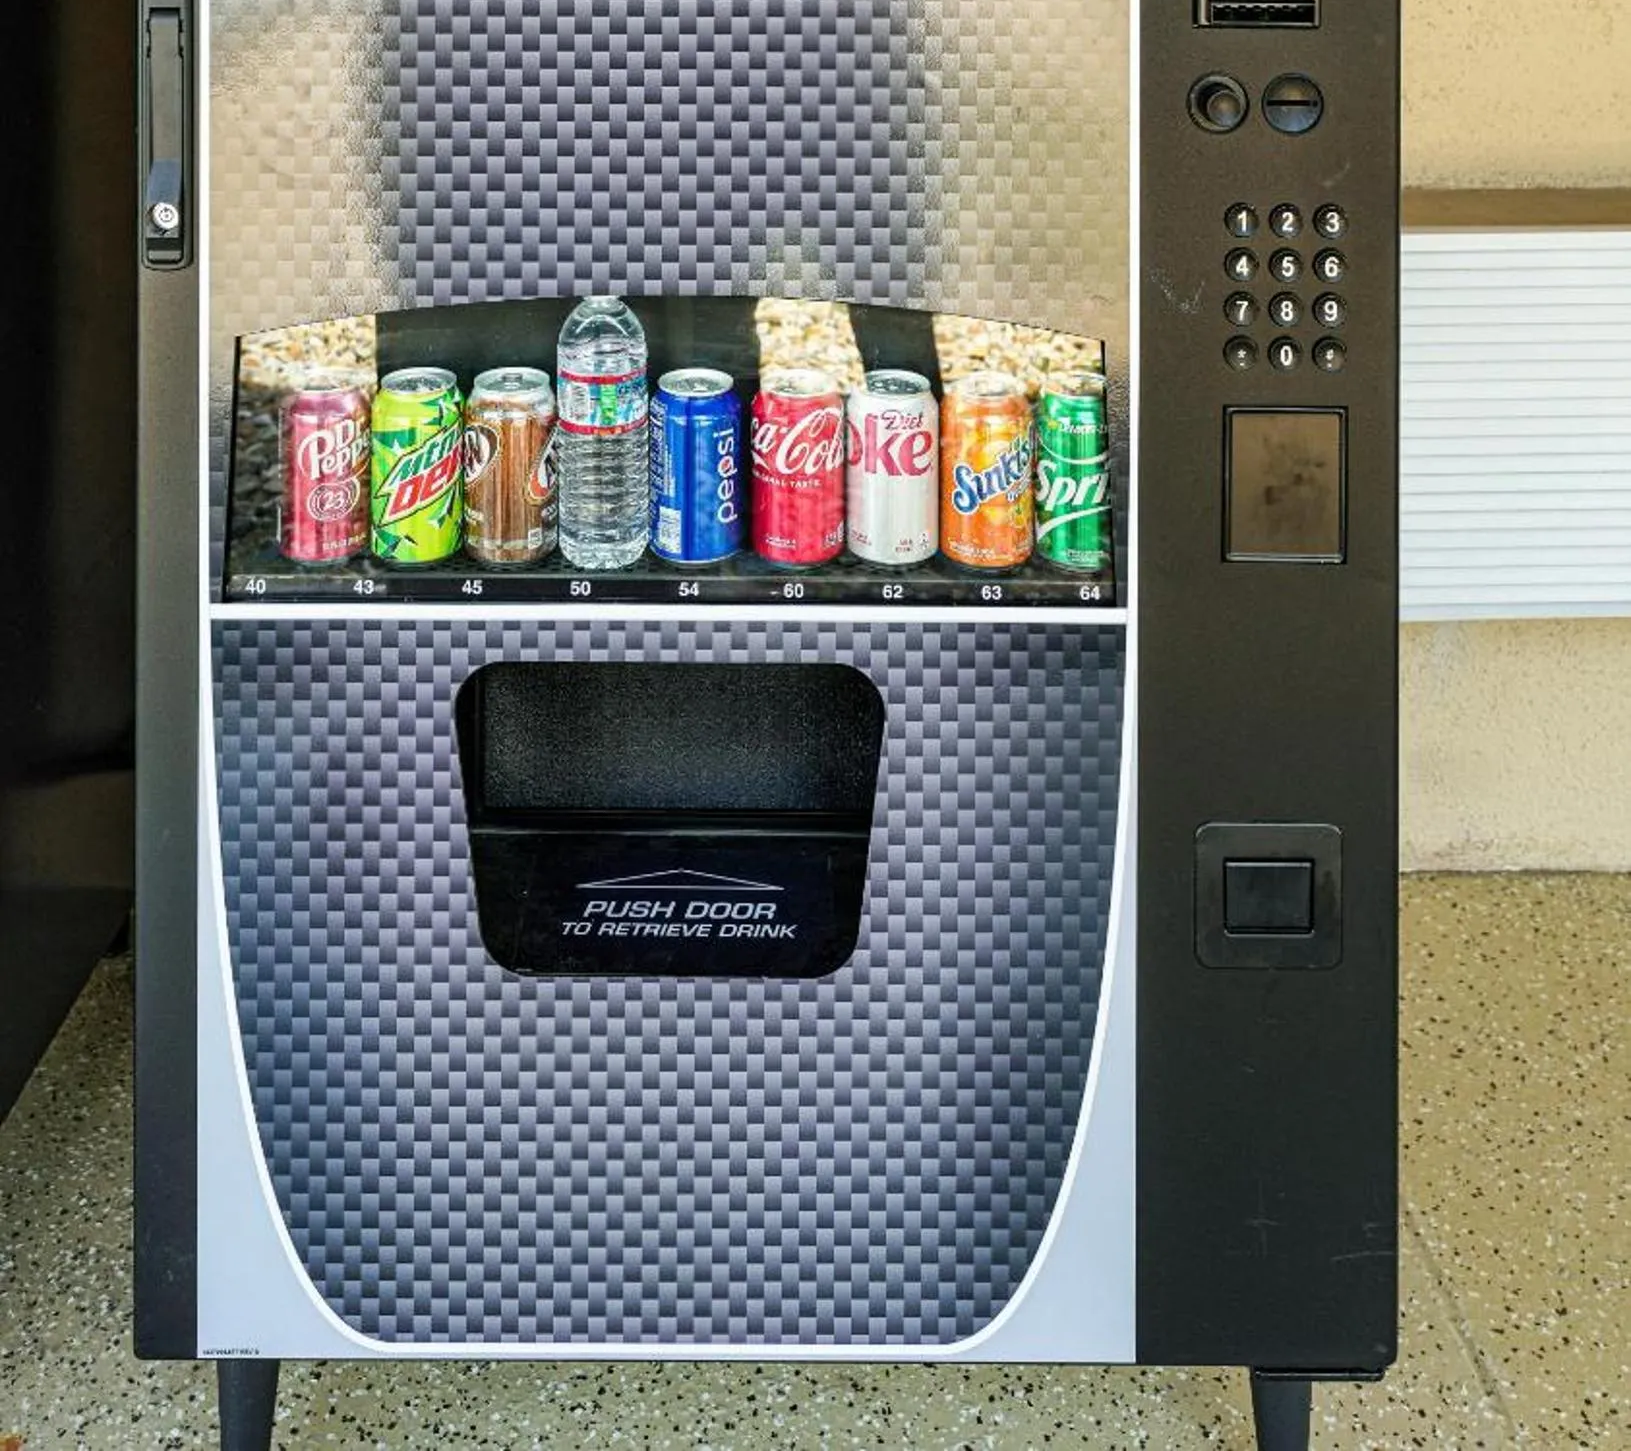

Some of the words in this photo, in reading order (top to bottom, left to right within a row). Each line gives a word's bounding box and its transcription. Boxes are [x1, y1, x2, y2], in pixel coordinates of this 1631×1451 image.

[1237, 212, 1248, 232] 1
[1281, 212, 1293, 232] 2
[1326, 212, 1340, 233] 3
[1235, 256, 1249, 276] 4
[1282, 256, 1295, 277] 5
[1324, 256, 1340, 277] 6
[1236, 301, 1248, 321] 7
[1281, 301, 1294, 322] 8
[1324, 301, 1338, 322] 9
[1280, 346, 1293, 366] 0
[713, 427, 738, 524] pepsi
[1036, 459, 1109, 512] Spri
[245, 580, 266, 594] 40
[353, 580, 374, 594] 43
[461, 580, 482, 594] 45
[570, 582, 591, 596] 50
[678, 582, 699, 596] 54
[783, 584, 804, 598] 60
[882, 585, 903, 599] 62
[981, 585, 1002, 599] 63
[1079, 585, 1101, 599] 64
[583, 901, 676, 919] PUSH
[684, 901, 777, 920] DOOR
[561, 922, 592, 936] TO
[597, 922, 713, 938] RETRIEVE
[718, 923, 799, 939] DRINK
